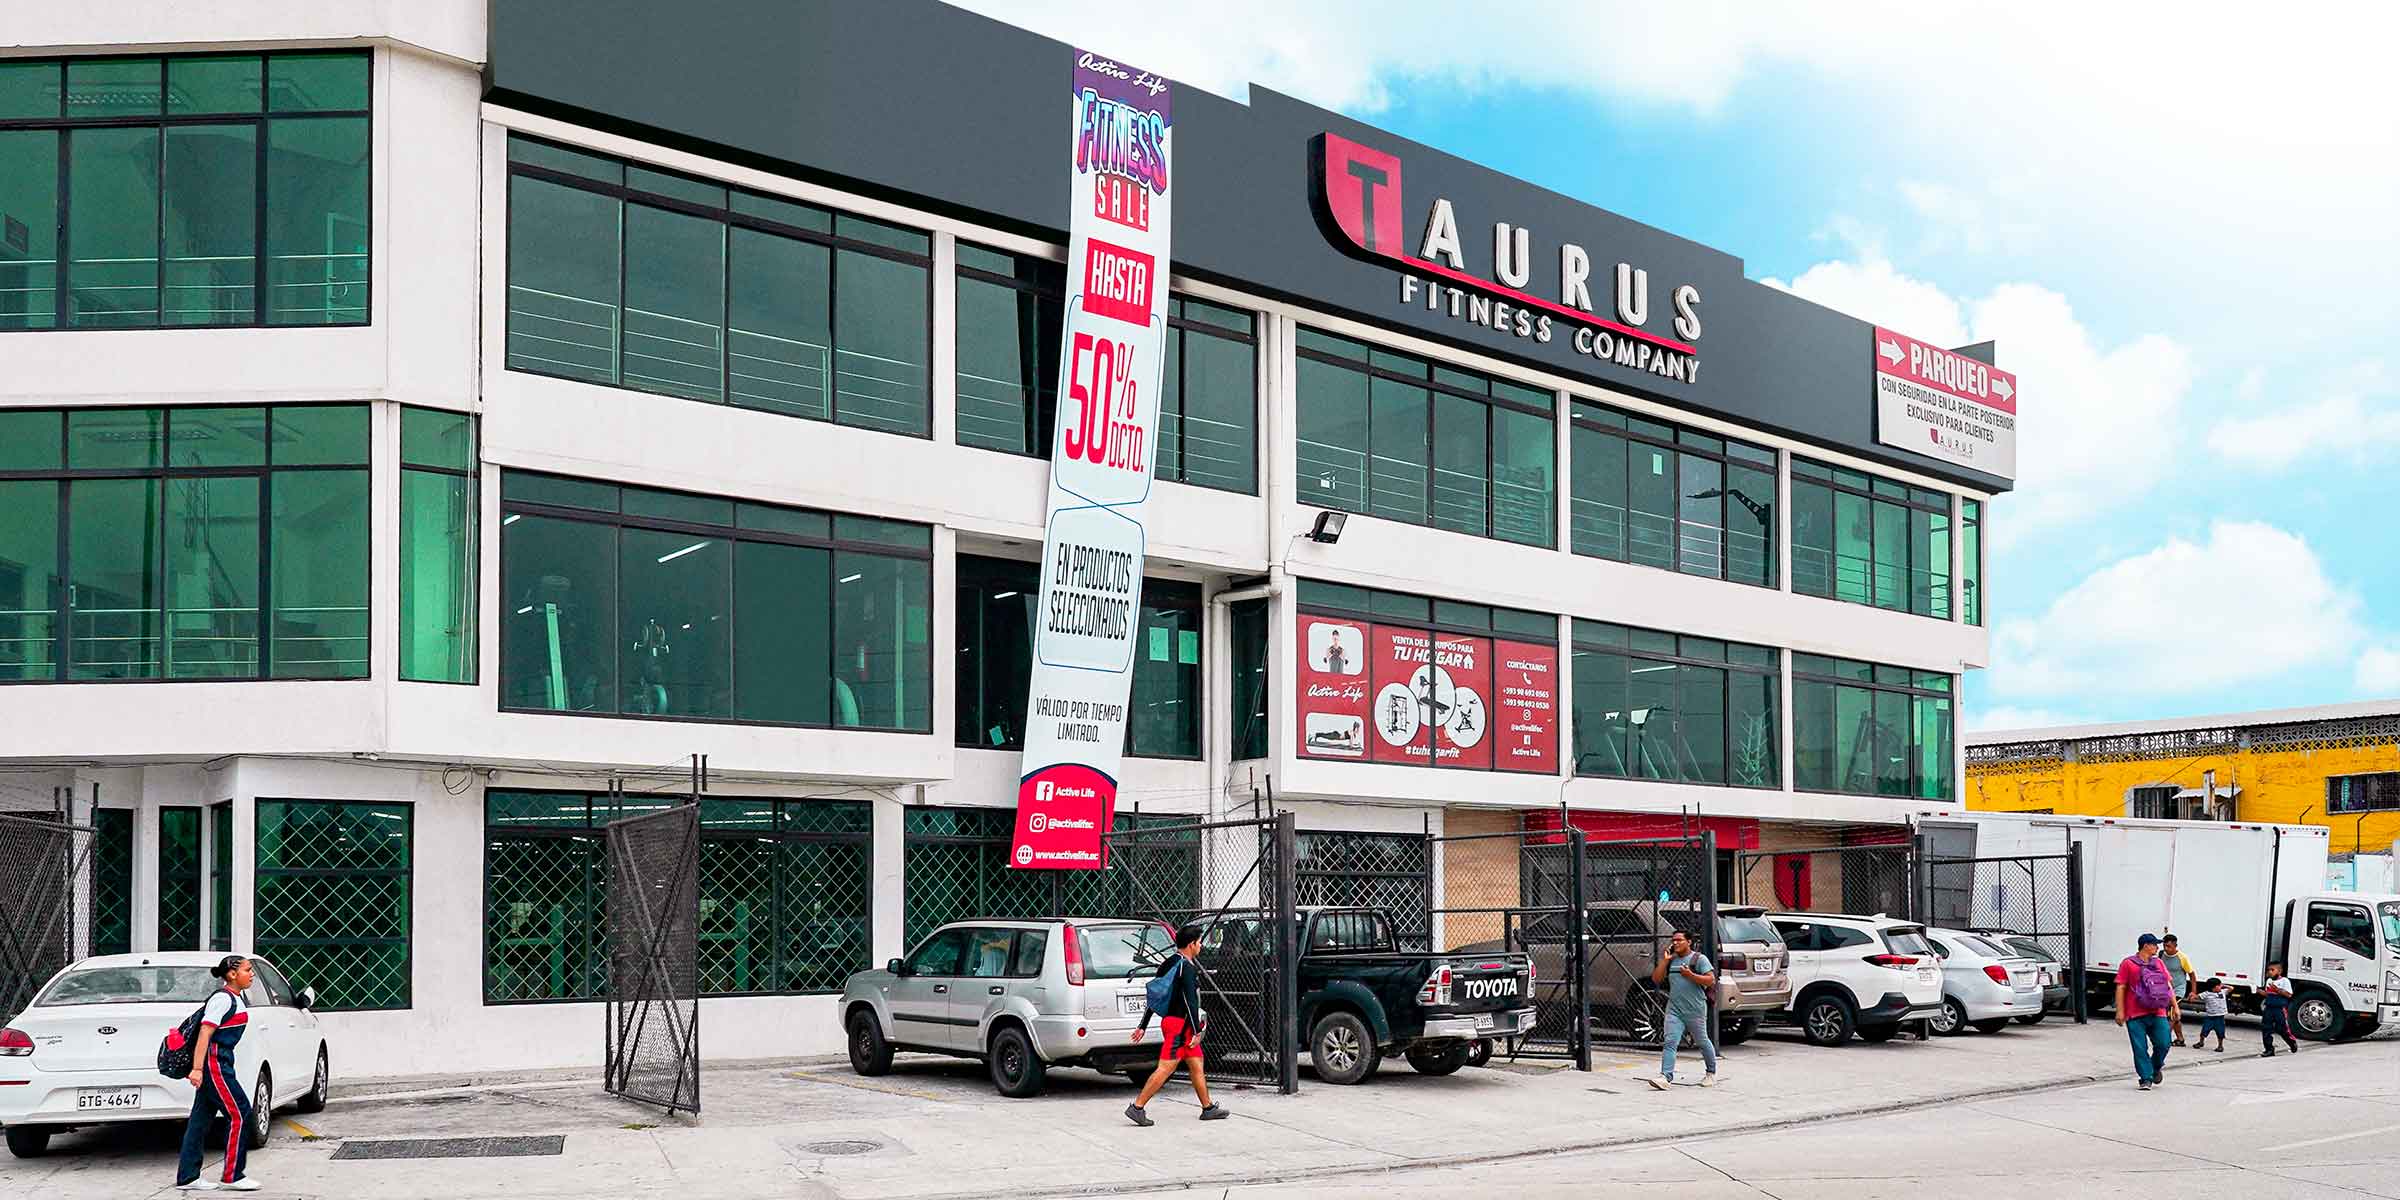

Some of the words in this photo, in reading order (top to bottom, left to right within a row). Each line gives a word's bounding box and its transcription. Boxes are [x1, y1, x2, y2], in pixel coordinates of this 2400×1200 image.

[1079, 53, 1129, 80] Active
[1133, 72, 1167, 96] Life
[1077, 90, 1167, 195] FITNESS
[1098, 175, 1148, 226] SALE
[1347, 159, 1701, 342] TAURUS
[1091, 249, 1146, 306] HASTA
[1402, 274, 1552, 343] FITNESS
[1573, 327, 1700, 384] COMPANY
[1909, 342, 1988, 398] PARQUEO
[1065, 332, 1136, 464] 50%
[1881, 377, 1896, 392] CON
[1898, 382, 1937, 407] SEGURIDAD
[1938, 396, 1948, 409] EN
[1948, 399, 1957, 412] LA
[1958, 402, 1979, 420] PARTE
[1980, 409, 2014, 432] POSTERIOR
[1108, 421, 1144, 473] DCTO.
[1907, 404, 1944, 426] EXCLUSIVO
[1945, 415, 1963, 433] PARA
[1964, 420, 1994, 443] CLIENTES
[1056, 542, 1072, 585] EN
[1072, 544, 1132, 594] PRODUCTOS
[1049, 591, 1130, 640] SELECCIONADOS
[1392, 635, 1414, 646] VENTA
[1414, 639, 1424, 647] DE
[1457, 644, 1474, 653] PARA
[1394, 646, 1412, 661] TU
[1413, 648, 1464, 667] HOGAR
[1036, 694, 1068, 718] VÁLIDO
[1070, 701, 1089, 719] POR
[1090, 702, 1122, 722] TIEMPO
[1308, 684, 1340, 696] Active
[1342, 686, 1363, 703] Life
[1057, 723, 1100, 742] LIMITADO.
[1056, 787, 1080, 797] Active
[1081, 788, 1095, 797] Life
[1464, 978, 1518, 998] TOYOTA
[79, 1094, 139, 1107] GTG-4647
